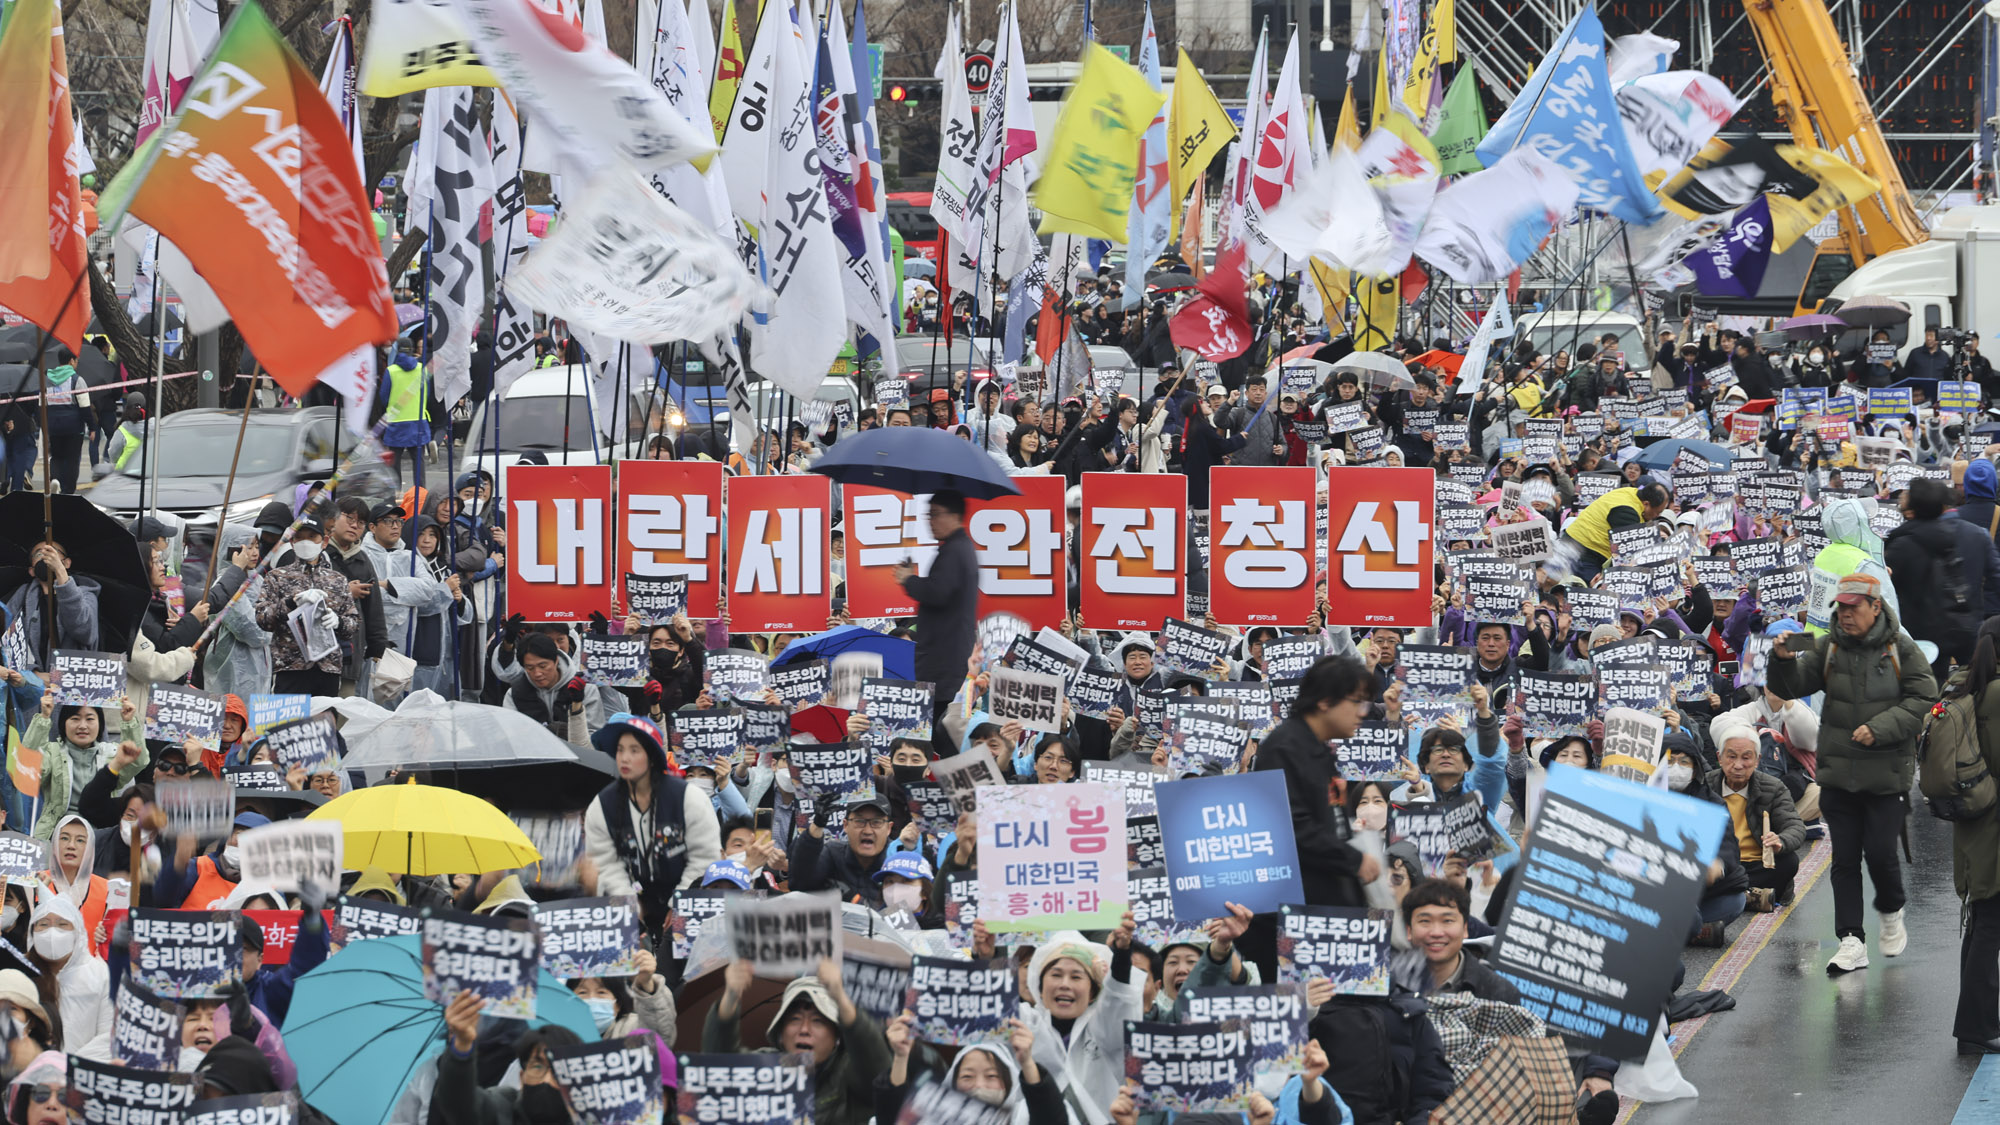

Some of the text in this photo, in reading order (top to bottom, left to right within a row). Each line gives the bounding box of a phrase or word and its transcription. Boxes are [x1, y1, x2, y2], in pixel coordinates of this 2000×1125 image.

[969, 65, 988, 81] 40
[1284, 369, 1316, 378] 민주주의가
[1328, 404, 1361, 418] 민주주의가
[1332, 414, 1360, 422] 승리했다
[1404, 410, 1439, 419] 민주주의가
[1434, 424, 1468, 432] 민주주의가
[1526, 423, 1561, 431] 민주주의가
[1573, 418, 1603, 426] 민주주의가
[1351, 428, 1383, 442] 민주주의가
[1356, 436, 1382, 449] 승리했다
[1437, 432, 1466, 441] 승리했다
[1523, 438, 1556, 447] 민주주의가
[1525, 446, 1553, 455] 승리했다
[1450, 465, 1486, 474] 민주주의가
[1732, 460, 1767, 470] 민주주의가
[1453, 474, 1482, 483] 승리했다
[1578, 477, 1618, 487] 민주주의가
[1673, 476, 1710, 486] 민주주의가
[1677, 484, 1707, 496] 승리했다
[1766, 498, 1795, 509] 승리했다
[1441, 509, 1484, 518] 민주주의가
[1444, 518, 1480, 528] 승리했다
[513, 498, 603, 585] 내
[628, 494, 718, 581] 란
[1219, 497, 1309, 589] 청
[1335, 499, 1429, 589] 산
[1496, 527, 1544, 546] 내란세력
[1611, 526, 1658, 543] 민주주의가
[734, 507, 822, 595] 세
[969, 508, 1061, 595] 완
[1089, 506, 1177, 595] 전
[1618, 538, 1654, 554] 승리했다
[1731, 537, 1781, 558] 민주주의가
[1463, 563, 1516, 574] 민주주의가
[1737, 554, 1777, 571] 승리했다
[1604, 572, 1651, 583] 민주주의가
[627, 581, 686, 594] 민주주의가
[1469, 583, 1526, 597] 민주주의가
[1607, 582, 1646, 595] 승리했다
[1760, 585, 1805, 602] 승리했다
[632, 595, 679, 610] 승리했다
[1474, 596, 1519, 610] 승리했다
[1567, 592, 1619, 608] 민주주의가
[1572, 606, 1615, 618] 승리했다
[583, 639, 645, 655] 민주주의가
[1165, 623, 1227, 653] 민주주의가
[1166, 641, 1216, 665] 승리했다
[1264, 641, 1321, 660] 민주주의가
[1399, 651, 1474, 669] 민주주의가
[56, 656, 123, 675] 민주주의가
[587, 654, 640, 670] 승리했다
[706, 655, 766, 672] 민주주의가
[1267, 657, 1314, 674] 승리했다
[62, 674, 116, 689] 승리했다
[711, 670, 762, 684] 승리했다
[1406, 669, 1466, 685] 승리했다
[1600, 670, 1667, 685] 민주주의가
[775, 682, 823, 699] 승리했다
[863, 685, 930, 705] 민주주의가
[994, 680, 1057, 704] 내란세력
[1520, 676, 1596, 698] 민주주의가
[1606, 685, 1660, 700] 승리했다
[153, 689, 222, 717] 민주주의가
[865, 702, 922, 720] 승리했다
[993, 699, 1055, 723] 청산하자
[1526, 696, 1587, 716] 승리했다
[157, 708, 213, 730] 승리했다
[674, 713, 744, 733] 민주주의가
[268, 719, 333, 749] 민주주의가
[1180, 718, 1247, 745] 민주주의가
[276, 738, 328, 763] 승리했다
[683, 732, 738, 751] 승리했다
[1184, 736, 1238, 760] 승리했다
[790, 748, 867, 767] 민주주의가
[1336, 746, 1396, 762] 승리했다
[800, 766, 861, 785] 승리했다
[1202, 803, 1248, 830] 다시
[995, 805, 1109, 853] 다시 봄
[1185, 832, 1273, 863] 대한민국
[1005, 861, 1099, 885] 대한민국
[1176, 876, 1201, 891] 이재
[1218, 870, 1254, 886] 국민이
[1256, 866, 1292, 882] 명한다
[534, 905, 632, 931] 민주주의가
[133, 919, 237, 945] 민주주의가
[1285, 915, 1386, 942] 민주주의가
[424, 919, 534, 959] 민주주의가
[542, 929, 623, 954] 승리했다
[140, 946, 227, 970] 승리했다
[1293, 940, 1377, 966] 승리했다
[433, 953, 520, 985] 승리했다
[912, 966, 1013, 994] 민주주의가
[917, 994, 1004, 1018] 승리했다
[1189, 995, 1301, 1022] 민주주의가
[1131, 1031, 1247, 1059] 민주주의가
[553, 1046, 654, 1085] 민주주의가
[1141, 1059, 1238, 1085] 승리했다
[74, 1068, 195, 1107] 민주주의가
[684, 1065, 808, 1093] 민주주의가
[569, 1076, 647, 1111] 승리했다
[695, 1094, 796, 1123] 승리했다
